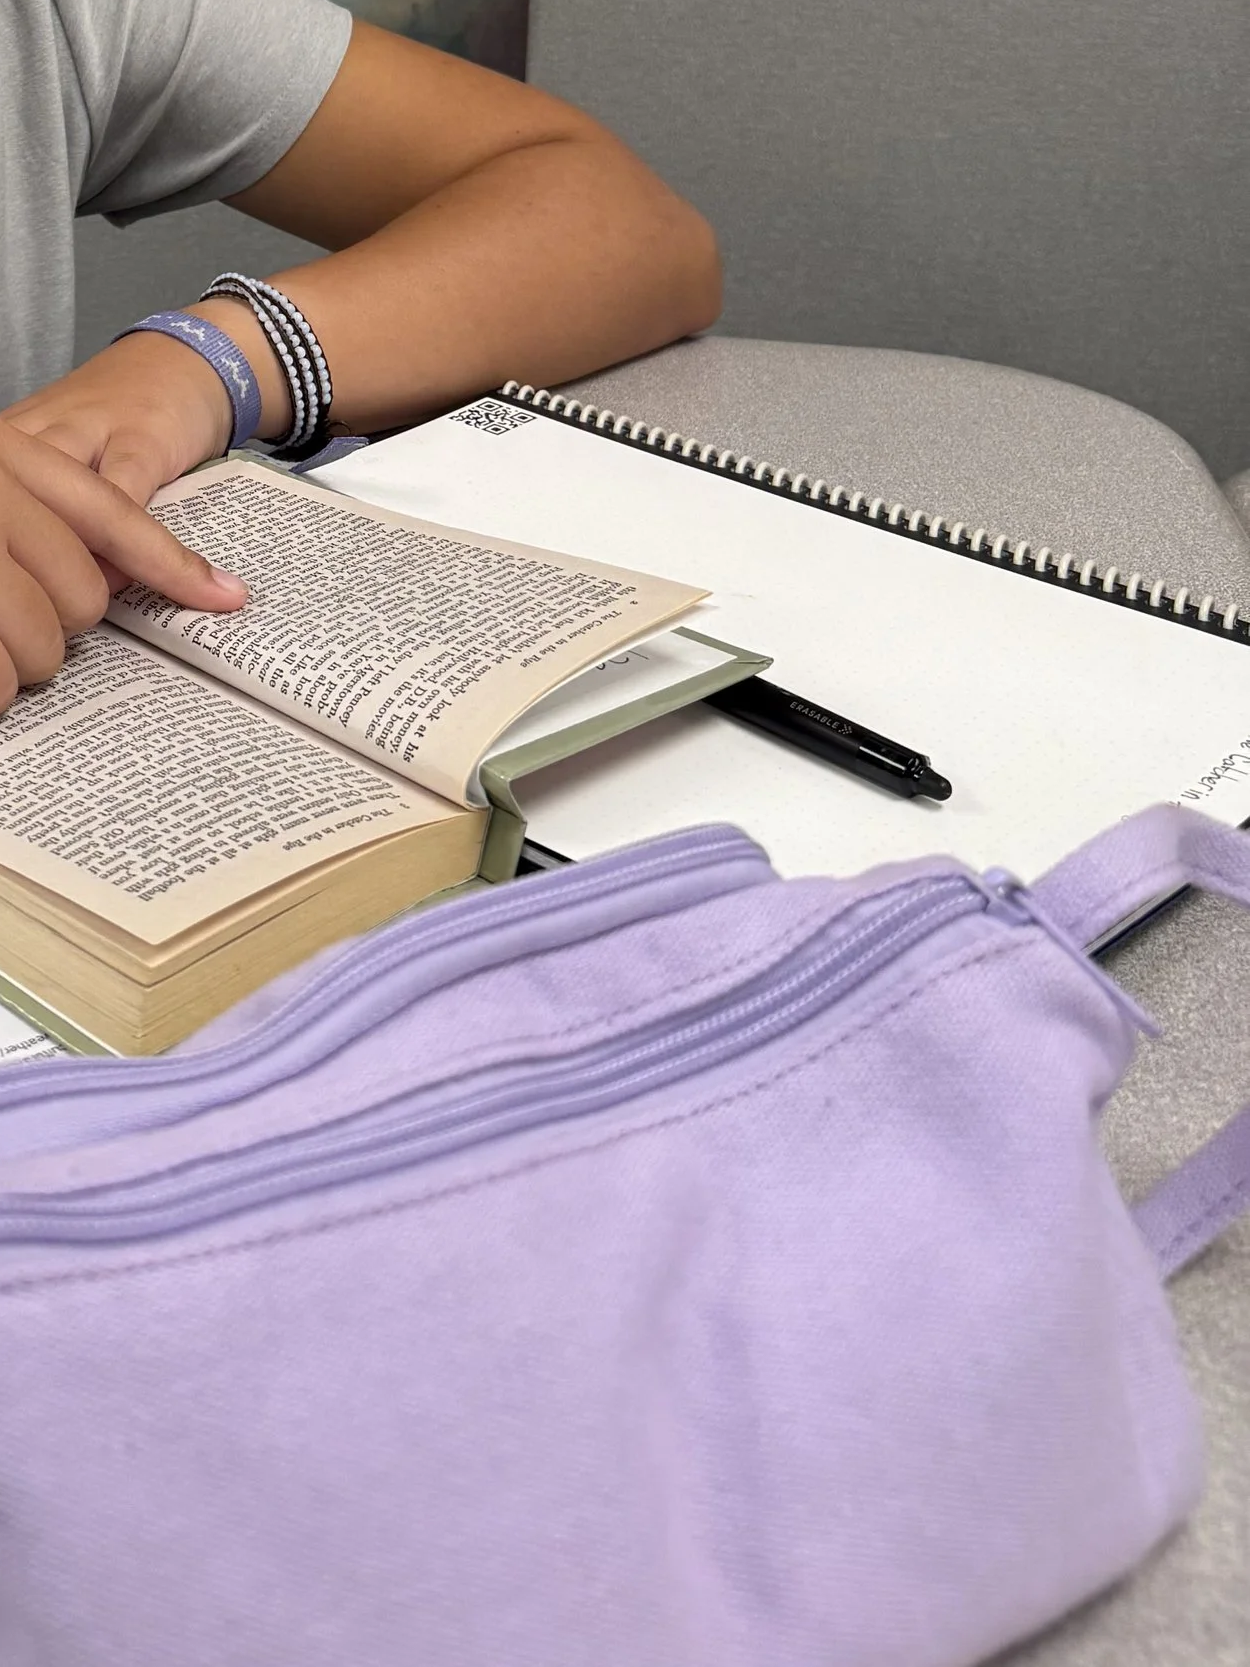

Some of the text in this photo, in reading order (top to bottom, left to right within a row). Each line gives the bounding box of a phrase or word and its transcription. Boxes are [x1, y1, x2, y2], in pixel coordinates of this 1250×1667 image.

[338, 686, 372, 728] Pencey
[789, 700, 842, 730] ERASABLE
[402, 741, 420, 763] his
